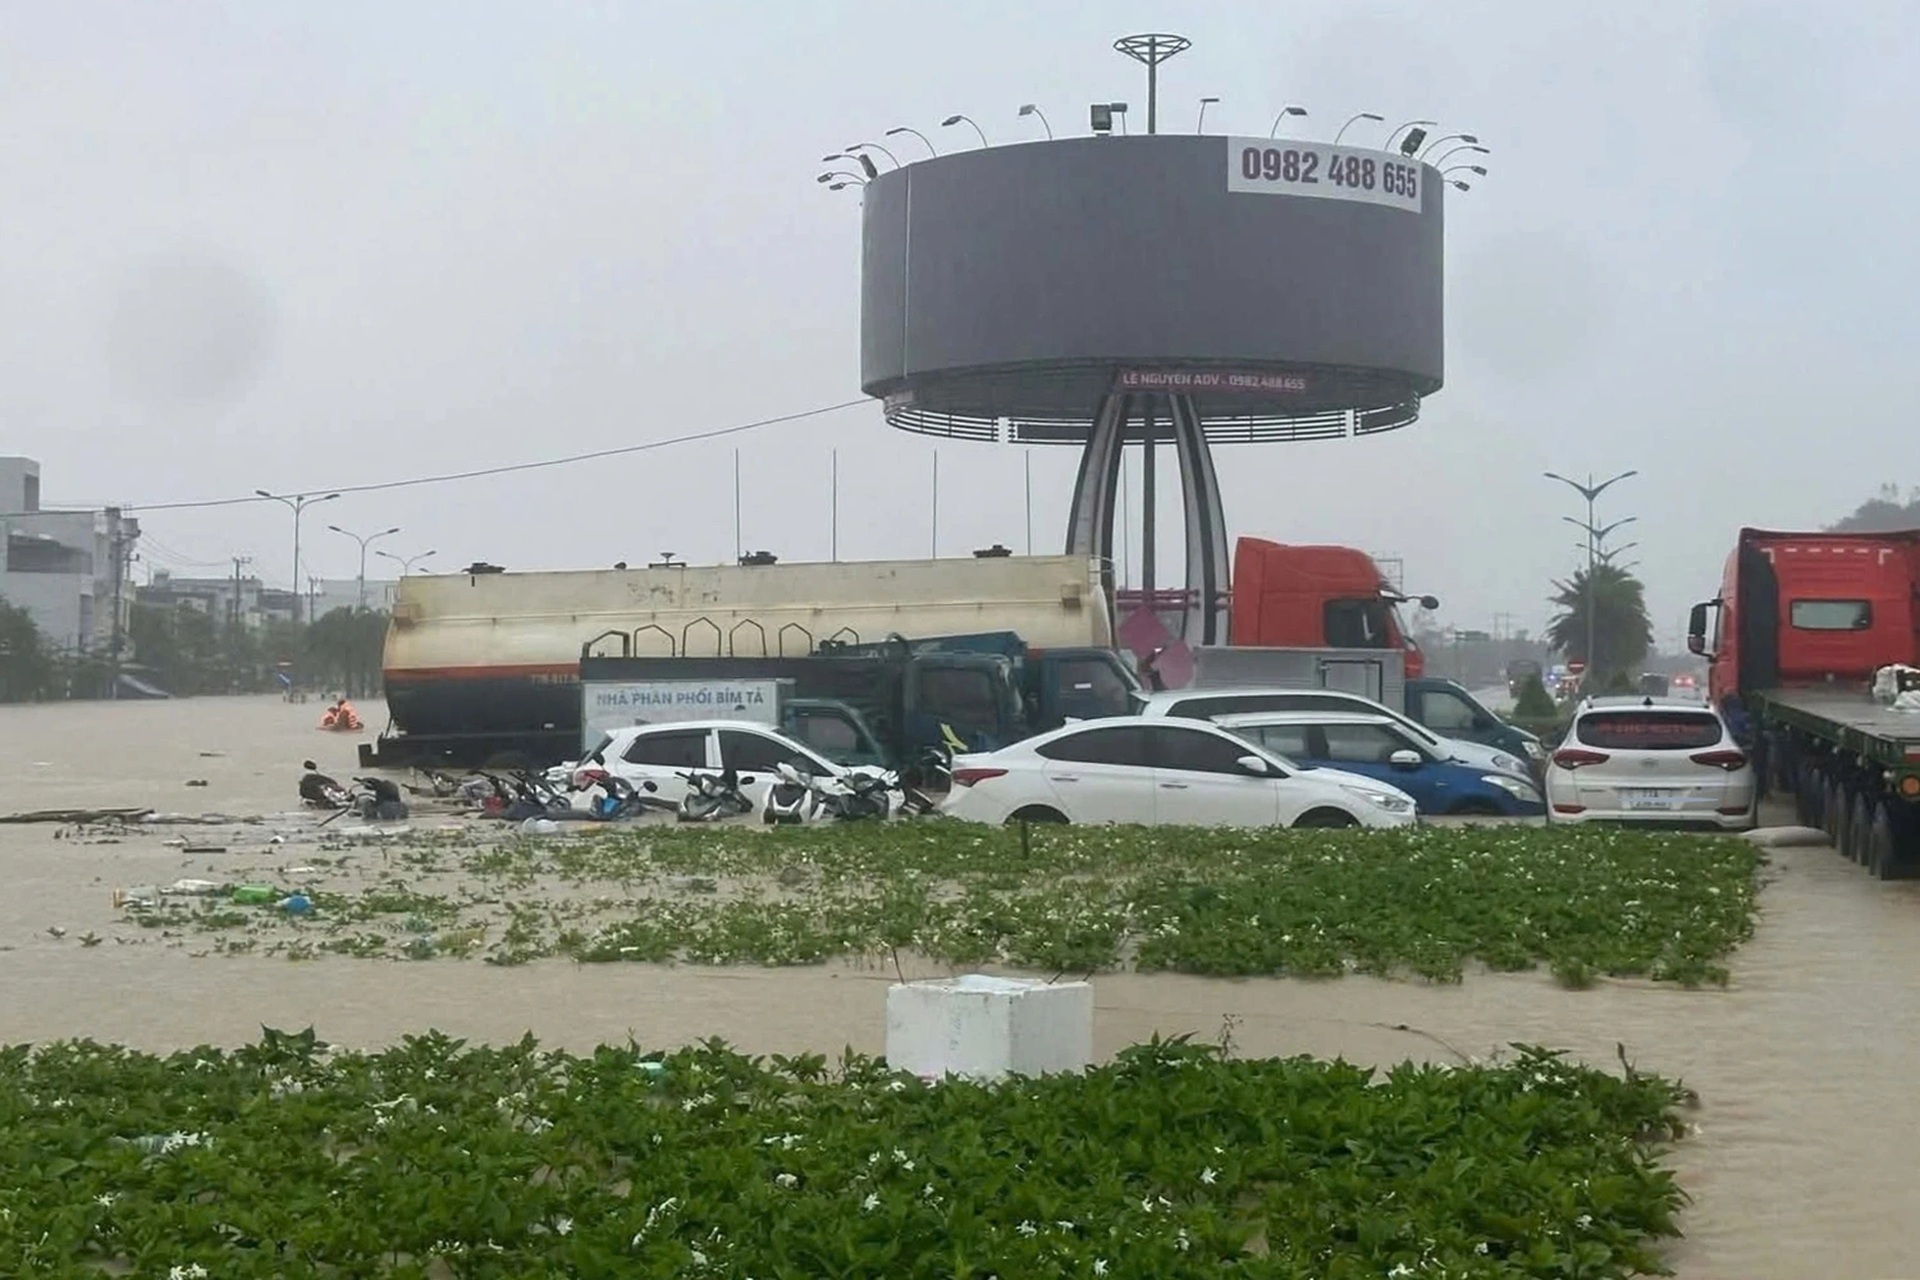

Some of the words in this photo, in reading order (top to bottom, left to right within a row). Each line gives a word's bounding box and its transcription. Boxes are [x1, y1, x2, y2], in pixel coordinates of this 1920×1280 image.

[1242, 147, 1318, 184] 0982
[1328, 154, 1375, 190] 488
[1383, 162, 1416, 199] 655
[1193, 373, 1219, 386] ADV
